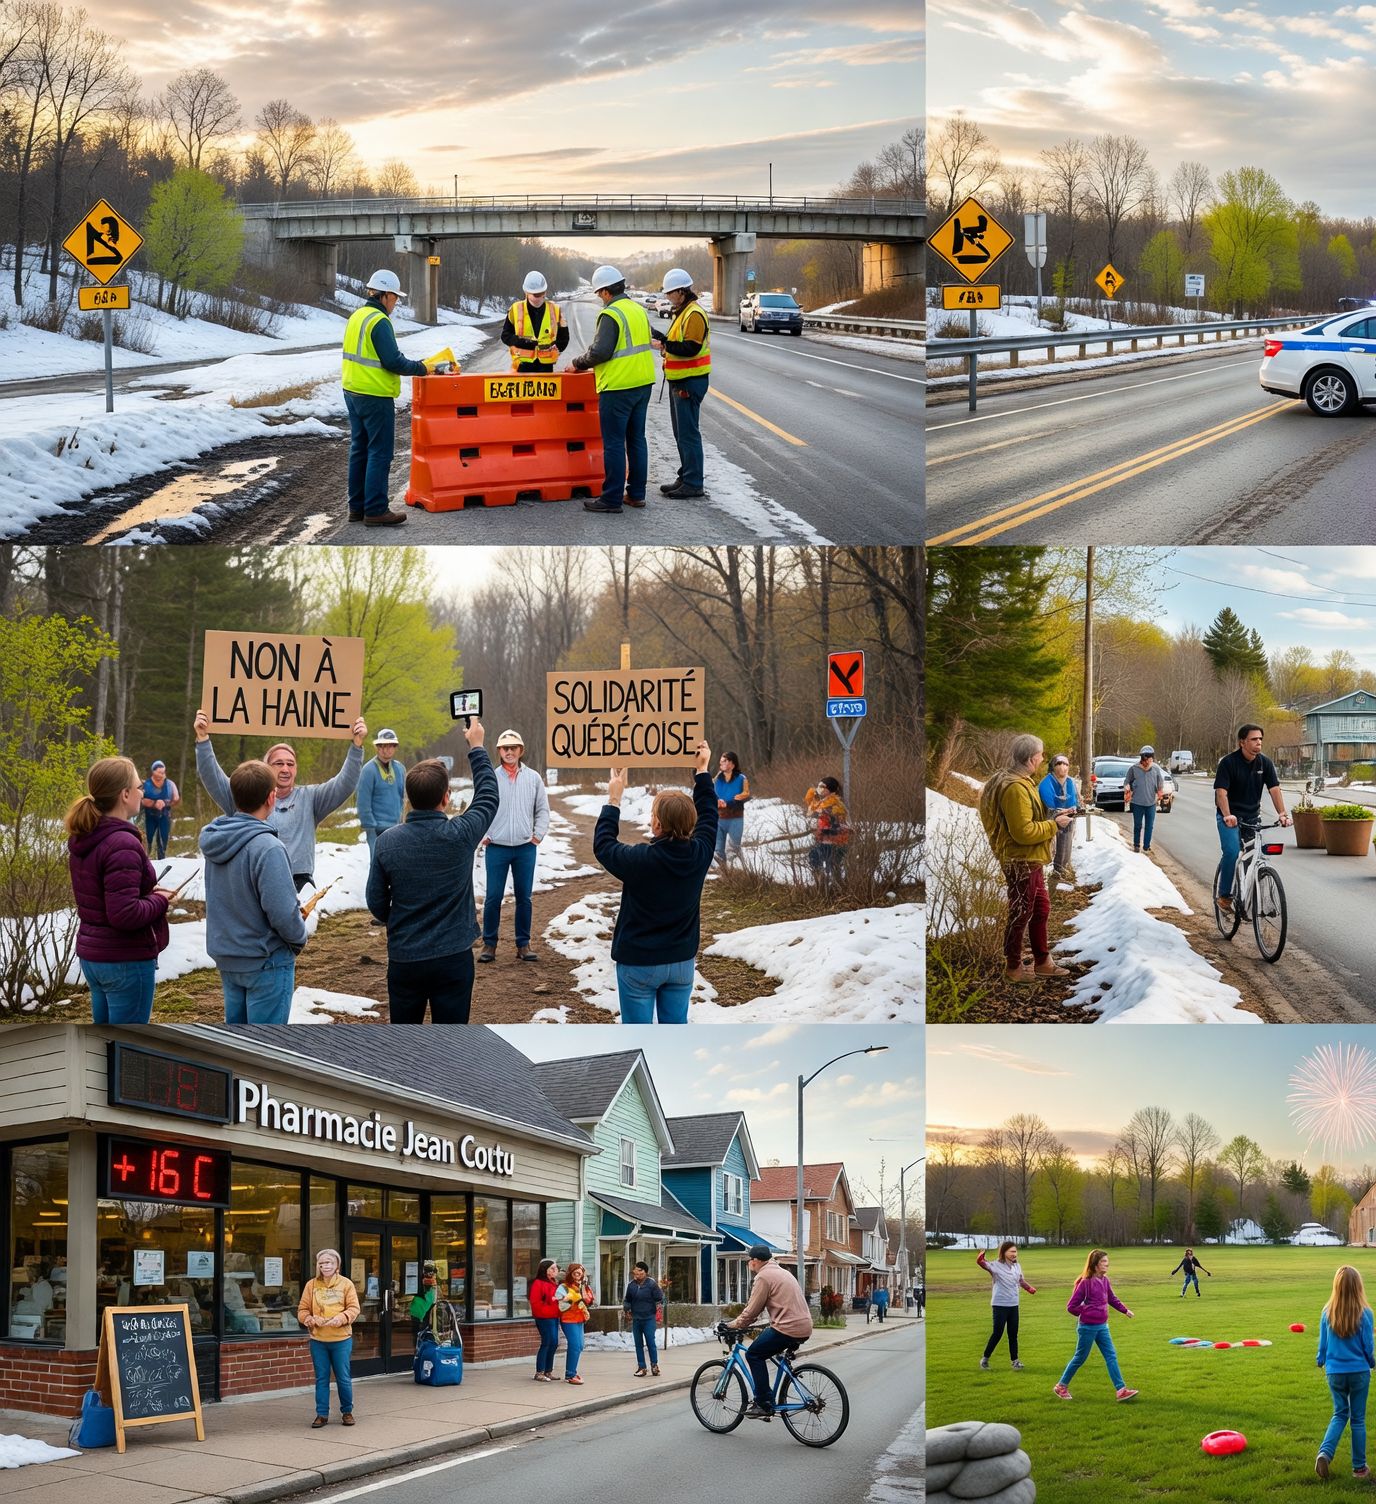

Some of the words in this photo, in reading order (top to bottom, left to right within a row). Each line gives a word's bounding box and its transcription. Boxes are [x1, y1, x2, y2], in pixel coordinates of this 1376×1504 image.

[230, 640, 301, 681] NON
[314, 637, 337, 684] À
[212, 686, 250, 724] LA
[262, 688, 352, 729] HAINE
[554, 669, 697, 714] SOLIDARITÉ
[237, 1079, 397, 1152] Pharmacie
[402, 1121, 455, 1164] Jean
